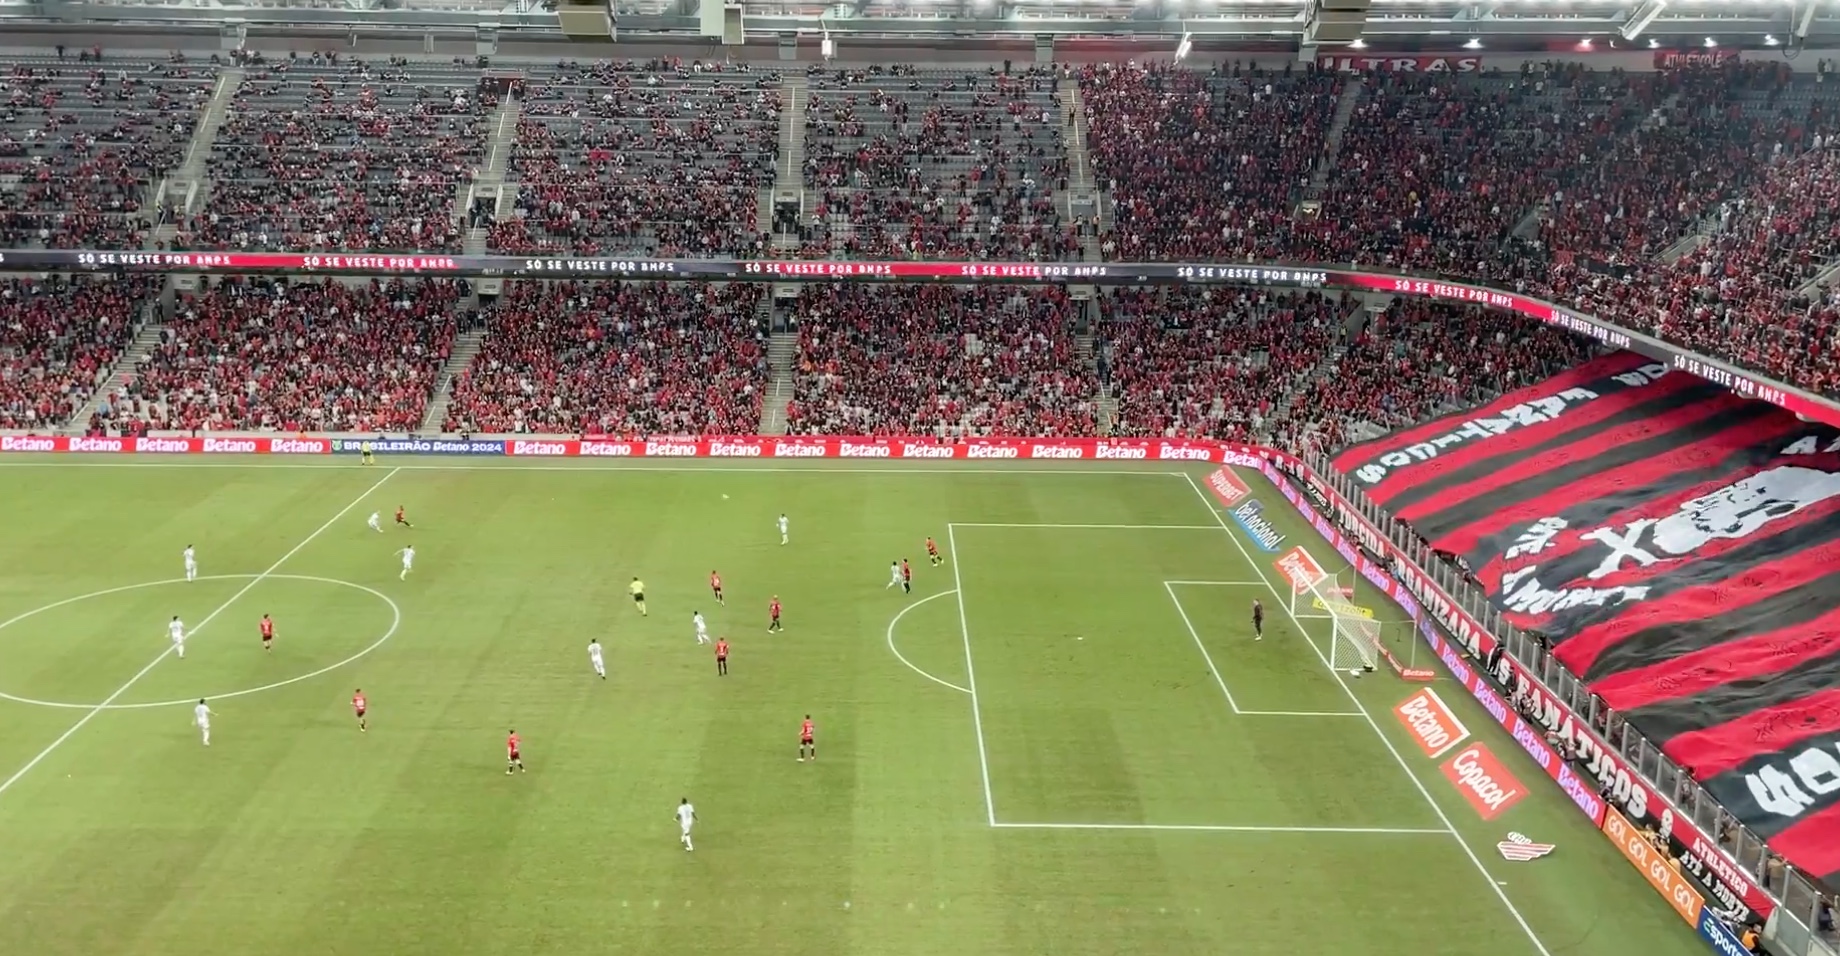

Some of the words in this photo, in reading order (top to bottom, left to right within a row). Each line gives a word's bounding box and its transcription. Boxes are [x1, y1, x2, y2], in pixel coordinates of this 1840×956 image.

[100, 254, 114, 264] SE
[122, 255, 160, 264] VESTE
[166, 255, 190, 264] POR
[325, 258, 340, 266] SE
[346, 258, 384, 267] VESTE
[390, 258, 414, 268] POR
[547, 260, 562, 270] SE
[568, 260, 606, 270] VESTE
[611, 261, 635, 270] POR
[766, 264, 780, 273] SE
[786, 264, 824, 273] VESTE
[829, 264, 852, 274] POR
[982, 266, 996, 275] SE
[1002, 266, 1040, 276] VESTE
[1044, 266, 1068, 276] POR
[1199, 268, 1214, 277] SE
[1220, 268, 1258, 278] VESTE
[1264, 270, 1288, 280] POR
[1415, 281, 1430, 292] SE
[1434, 284, 1465, 298] VESTE
[1470, 290, 1488, 302] POR
[1561, 313, 1570, 325] SE
[1570, 316, 1592, 335] VESTE
[1594, 325, 1608, 341] POR
[1688, 360, 1699, 374] SE
[1702, 363, 1732, 387] VESTE
[1734, 376, 1754, 395] POR
[0, 438, 54, 451] Betano
[68, 438, 122, 451] Betano
[136, 439, 189, 452] Betano
[202, 439, 256, 452] Betano
[270, 440, 324, 452] Betano
[344, 440, 431, 451] BRSILEIRÃO
[472, 443, 502, 452] 2024
[514, 441, 566, 455] Betano
[580, 441, 632, 455] Betano
[645, 442, 697, 456] Betano
[710, 442, 762, 456] Betano
[774, 443, 826, 457] Betano
[840, 444, 890, 457] Betano
[902, 444, 954, 458] Betano
[966, 444, 1018, 458] Betano
[1032, 445, 1083, 458] Betano
[1095, 445, 1146, 458] Betano
[1159, 446, 1211, 460] Betano
[1400, 695, 1450, 748] Betano
[1512, 717, 1551, 770] Betano
[1453, 749, 1517, 811] Copacol
[1557, 762, 1599, 820] Betano
[1608, 814, 1626, 844] GOL
[1628, 830, 1648, 868] GOL
[1650, 859, 1670, 892] GOL
[1674, 883, 1695, 918] GOL
